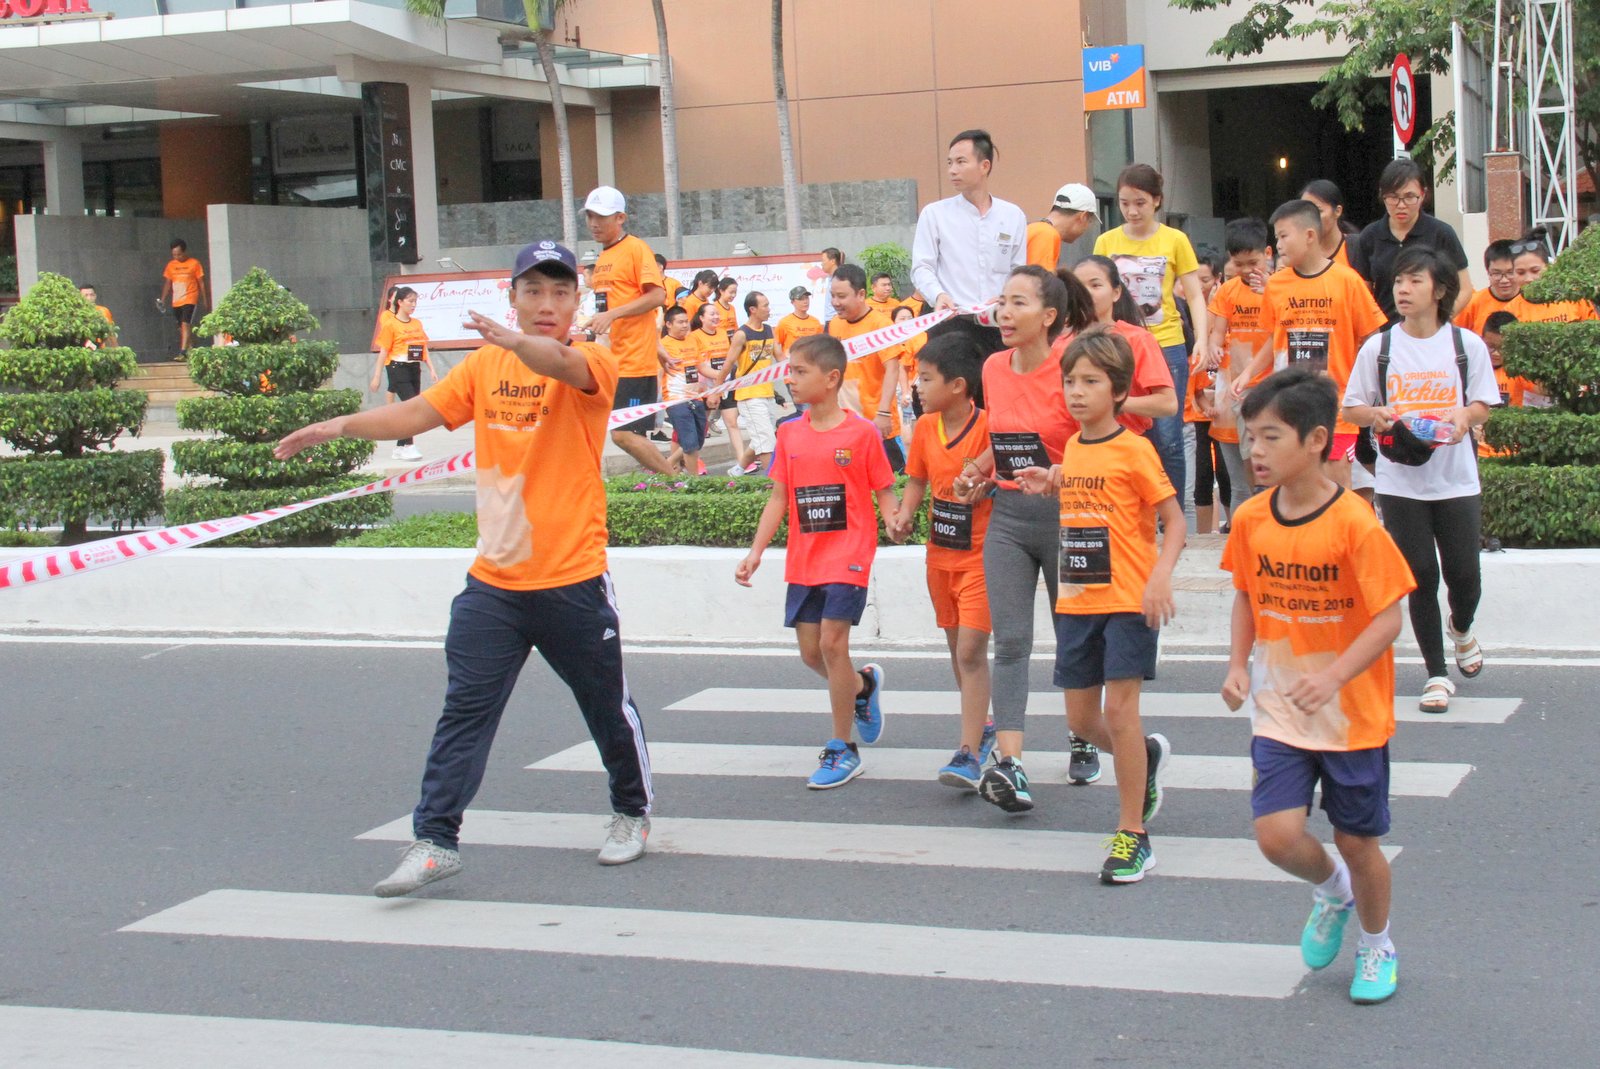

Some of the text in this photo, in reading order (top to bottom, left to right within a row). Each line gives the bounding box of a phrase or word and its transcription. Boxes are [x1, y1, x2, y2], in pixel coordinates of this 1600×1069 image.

[1088, 60, 1111, 72] VIB
[1106, 90, 1140, 105] ATM
[1285, 297, 1333, 311] Marriott
[1306, 317, 1323, 325] GIVE
[1296, 350, 1310, 360] 814
[1404, 370, 1449, 380] ORIGINAL
[1387, 374, 1457, 402] Dickies
[500, 411, 513, 421] TO
[515, 412, 537, 422] GIVE
[1009, 456, 1034, 467] 1004
[807, 508, 831, 519] 1001
[1093, 502, 1115, 513] 2018
[933, 521, 956, 536] 1002
[1069, 556, 1087, 568] 753
[1256, 553, 1339, 581] Marriott
[1287, 598, 1320, 611] GIVE
[1324, 597, 1354, 611] 2018
